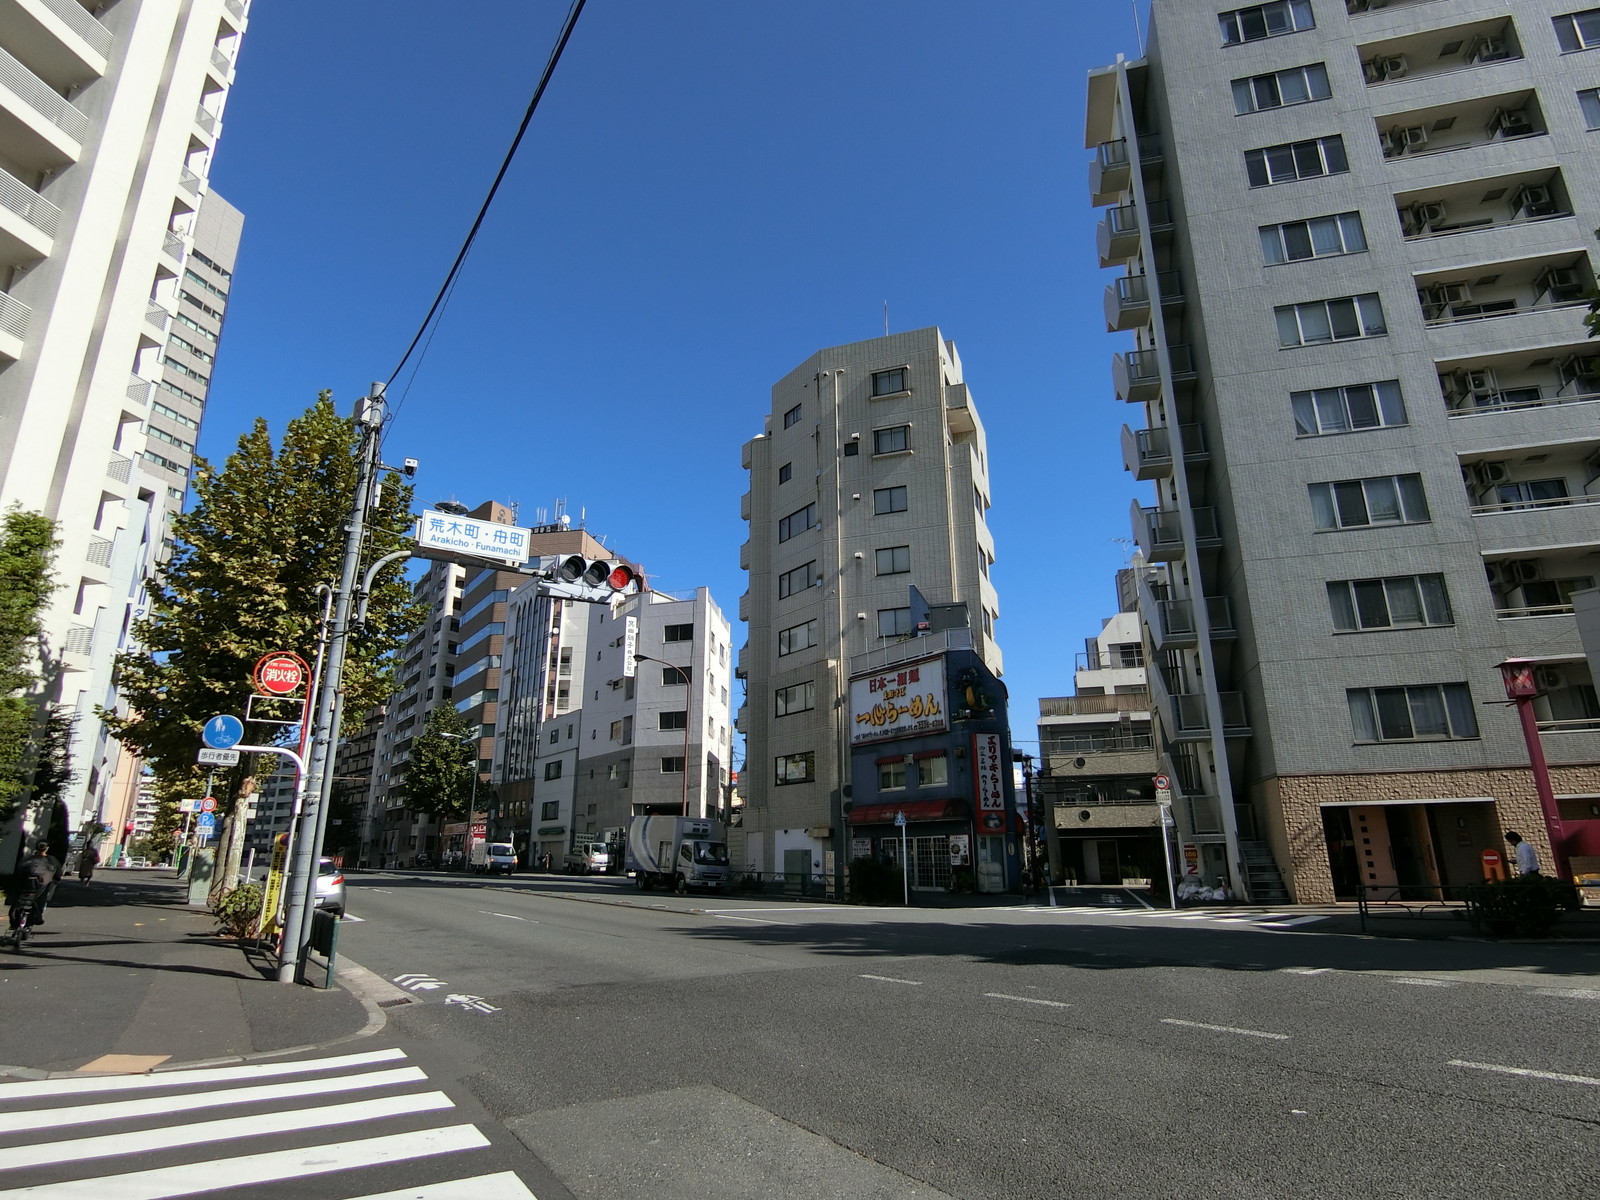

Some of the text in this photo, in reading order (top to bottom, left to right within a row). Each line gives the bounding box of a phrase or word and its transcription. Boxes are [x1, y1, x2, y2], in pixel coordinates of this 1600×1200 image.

[429, 517, 525, 548] 荒木町・舟町
[430, 534, 521, 557] Arakicho Funamachi
[265, 668, 298, 683] 消火栓
[200, 751, 237, 761] 歩行者優先
